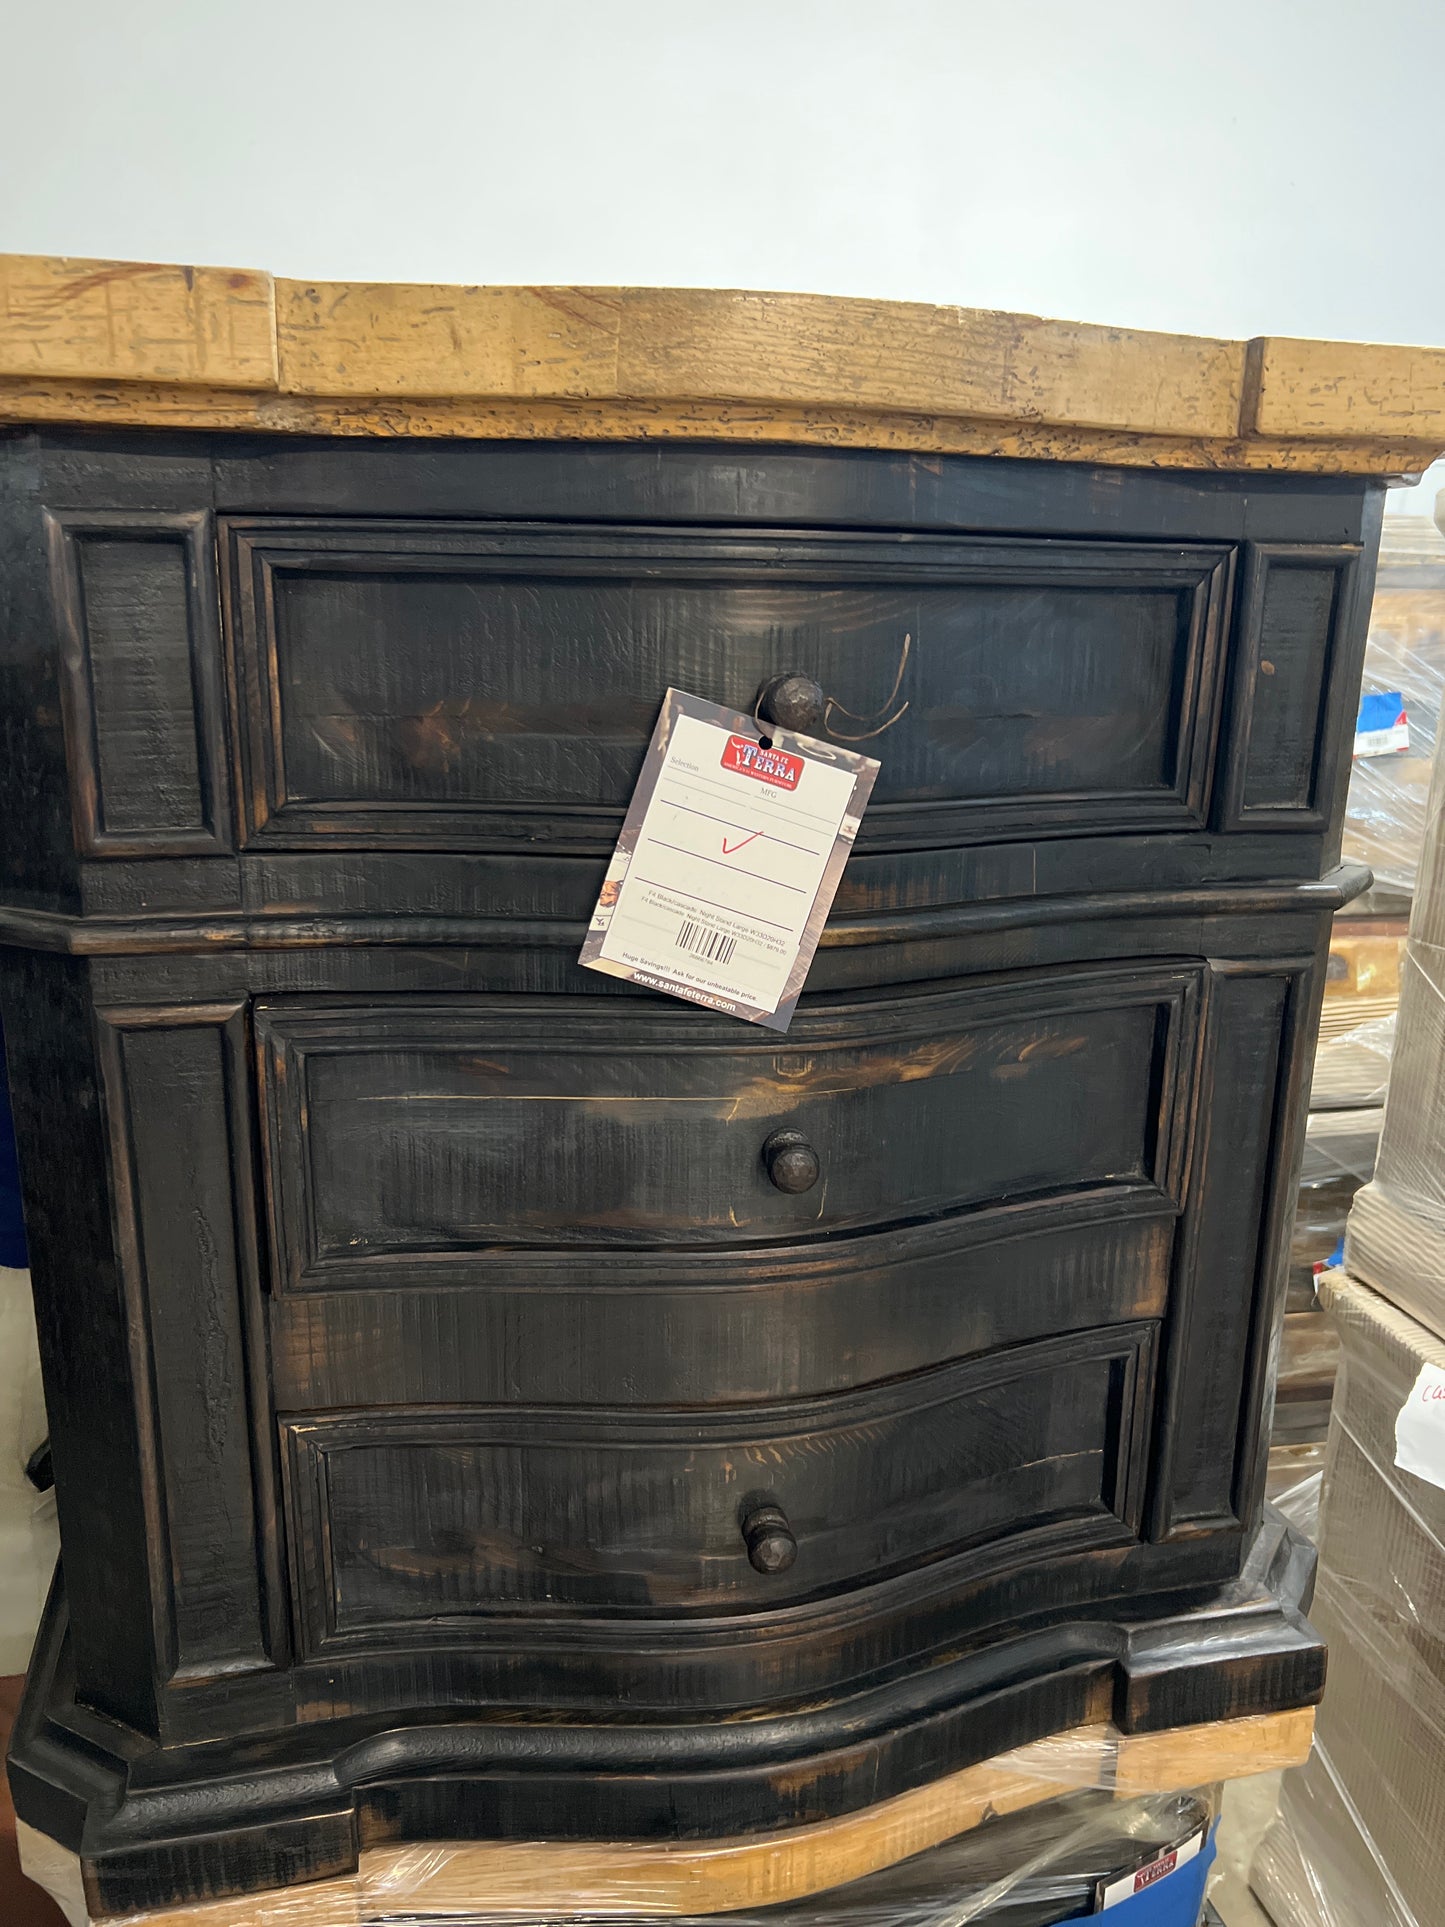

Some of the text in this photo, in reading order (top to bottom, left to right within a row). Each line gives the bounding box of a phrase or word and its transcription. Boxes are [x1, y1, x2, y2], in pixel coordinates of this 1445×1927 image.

[670, 756, 699, 771] Selection
[742, 744, 794, 781] TERRA
[759, 750, 780, 760] SANTA
[760, 788, 777, 798] MFG
[623, 952, 639, 961] Huge
[707, 981, 740, 994] unbeatable
[633, 972, 736, 1010] www.santafeterra.com
